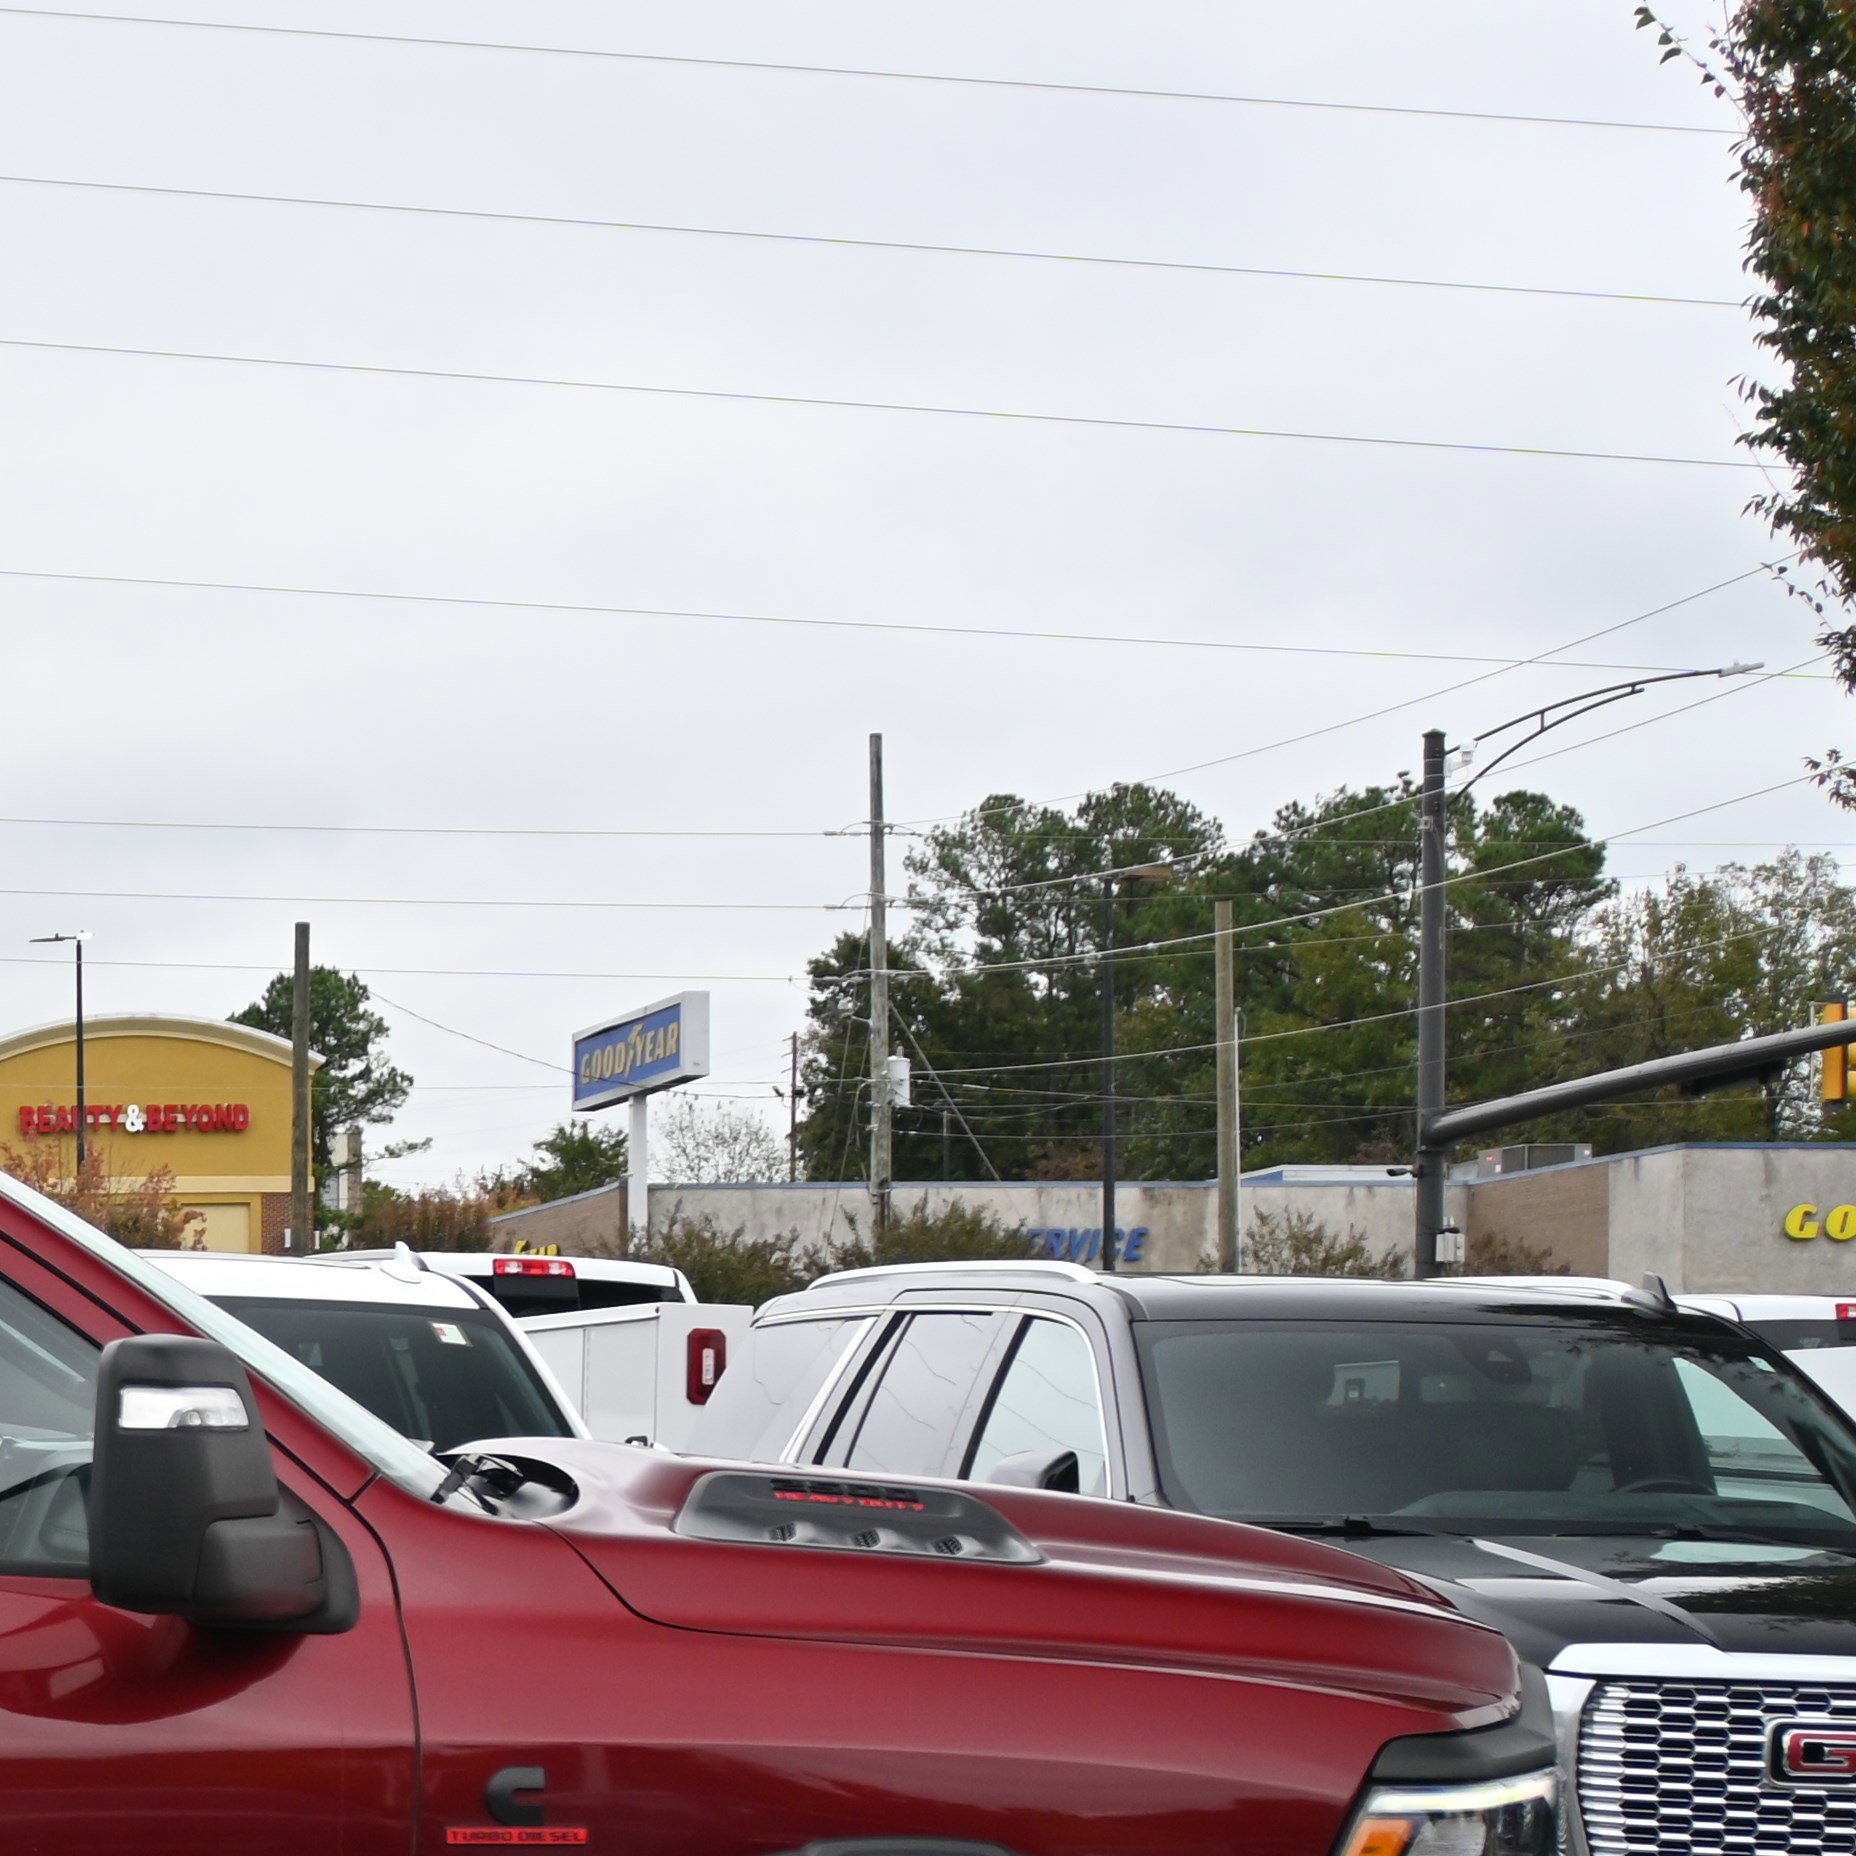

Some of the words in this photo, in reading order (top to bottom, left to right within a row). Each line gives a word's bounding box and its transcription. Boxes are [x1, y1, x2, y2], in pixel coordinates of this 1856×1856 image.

[581, 1022, 680, 1084] GOODYEAR
[125, 1104, 145, 1132] &
[146, 1103, 250, 1132] BEYOND
[450, 1830, 513, 1842] TURBO
[518, 1830, 585, 1842] DIESEL
